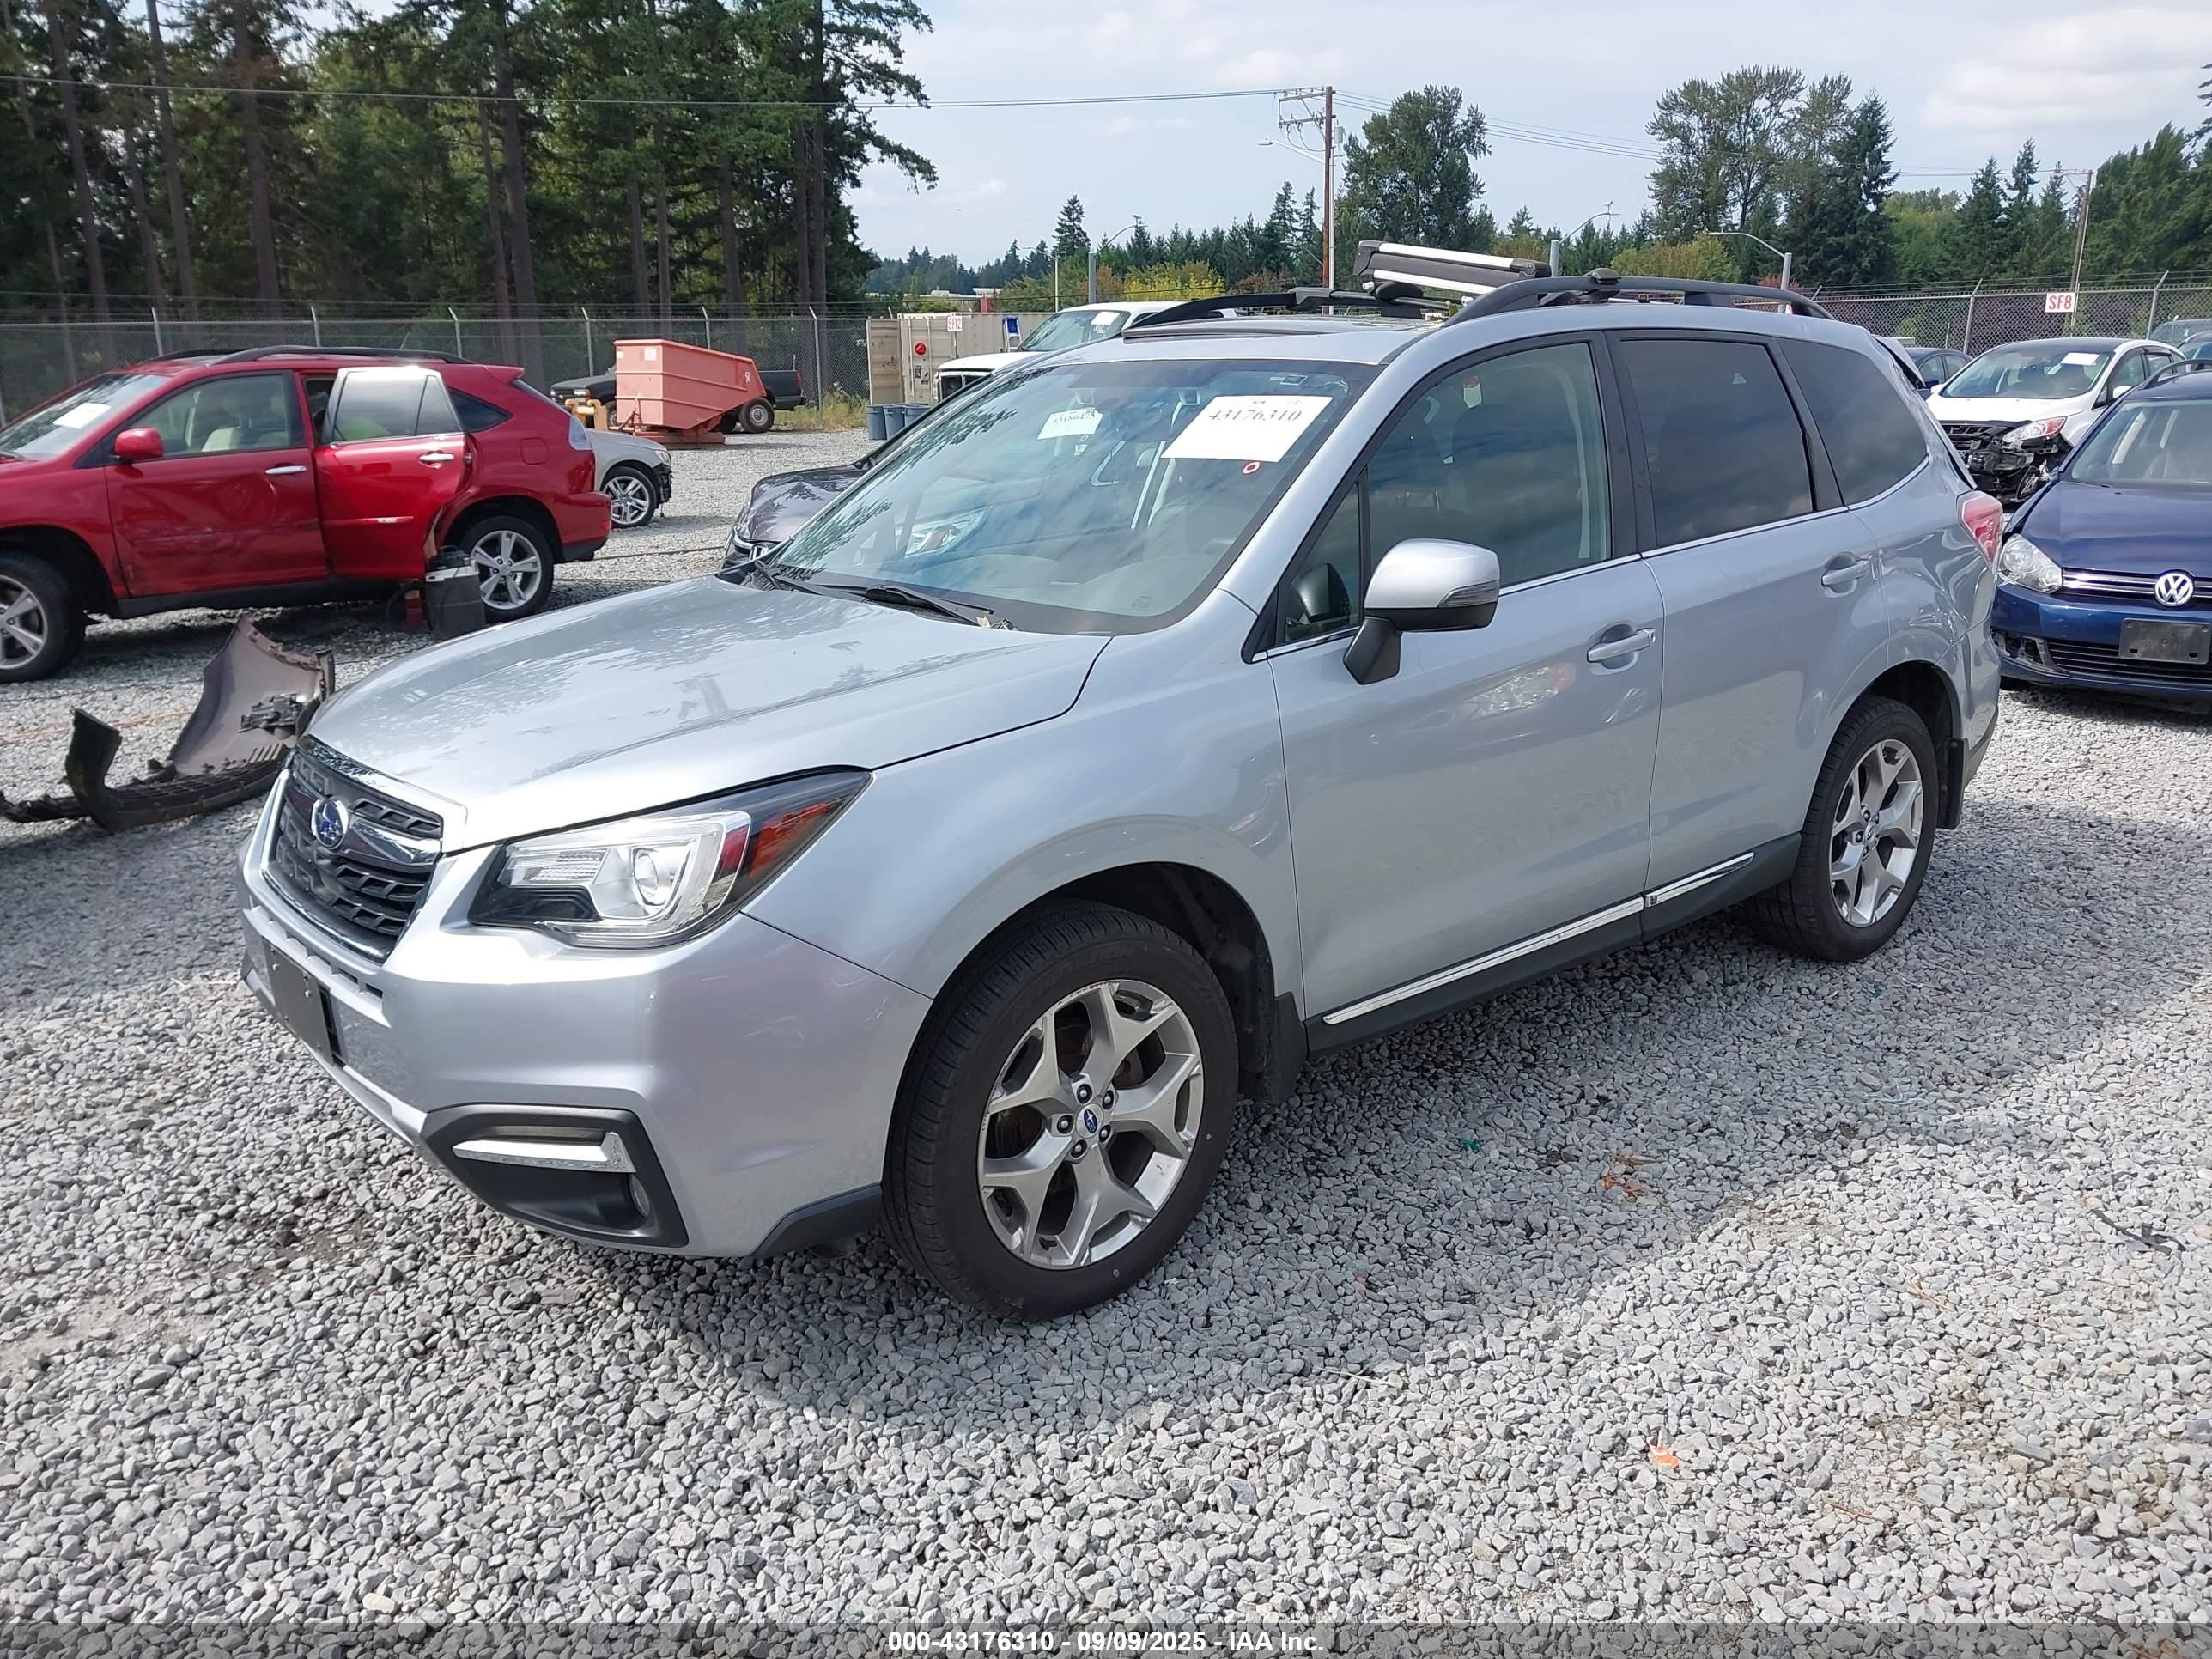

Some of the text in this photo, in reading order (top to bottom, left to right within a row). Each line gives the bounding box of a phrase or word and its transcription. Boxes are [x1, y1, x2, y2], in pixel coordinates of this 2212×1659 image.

[2049, 295, 2072, 310] SF8
[948, 318, 962, 331] SF12
[1208, 409, 1303, 422] 43176310
[2155, 574, 2193, 606] VW
